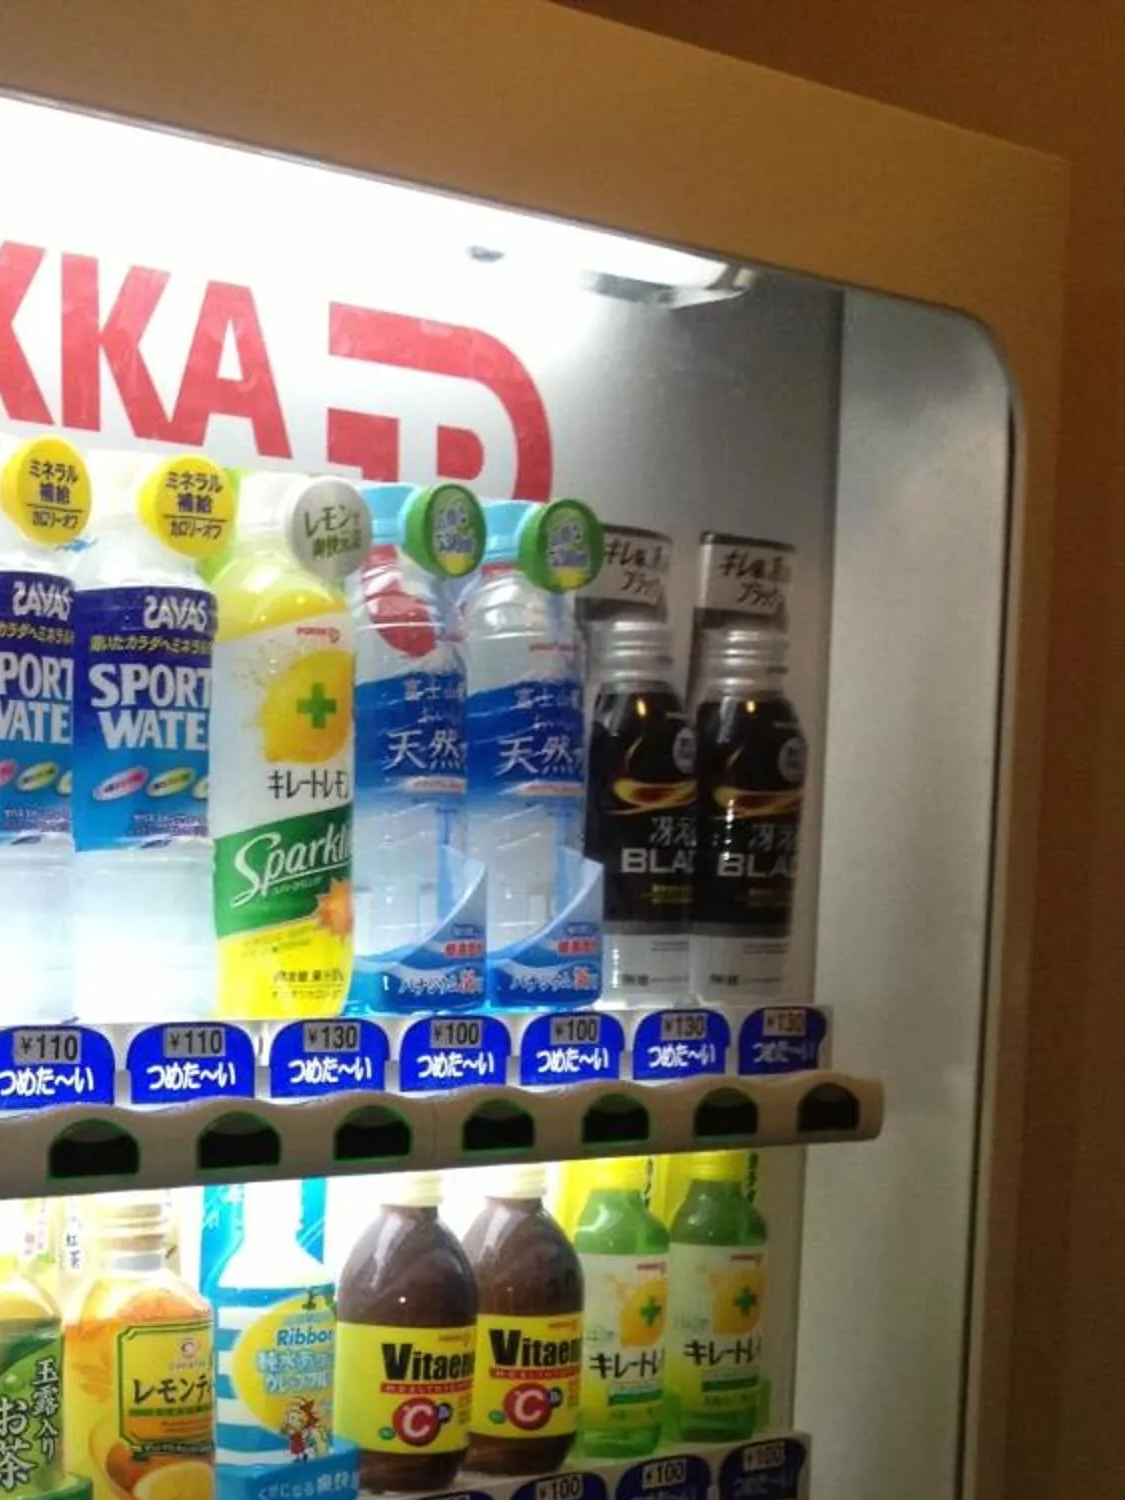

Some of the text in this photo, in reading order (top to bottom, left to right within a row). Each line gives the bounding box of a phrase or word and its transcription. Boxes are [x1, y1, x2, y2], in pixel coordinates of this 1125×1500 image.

[28, 459, 78, 482] ミネラル
[165, 471, 223, 493] ミネラル
[39, 483, 70, 504] 補給
[177, 493, 213, 514] 補給
[144, 595, 209, 632] SAVAS
[307, 1025, 357, 1050] ¥130
[433, 1019, 480, 1046] ¥100
[556, 1016, 598, 1042] ¥100
[663, 1012, 706, 1039] ¥130
[20, 1034, 78, 1061] ¥110
[169, 1029, 222, 1056] ¥110
[32, 1358, 60, 1461] 玉露入り
[514, 1389, 544, 1422] C
[401, 1405, 434, 1438] C
[645, 1461, 685, 1483] ¥100
[538, 1477, 582, 1500] ¥100
